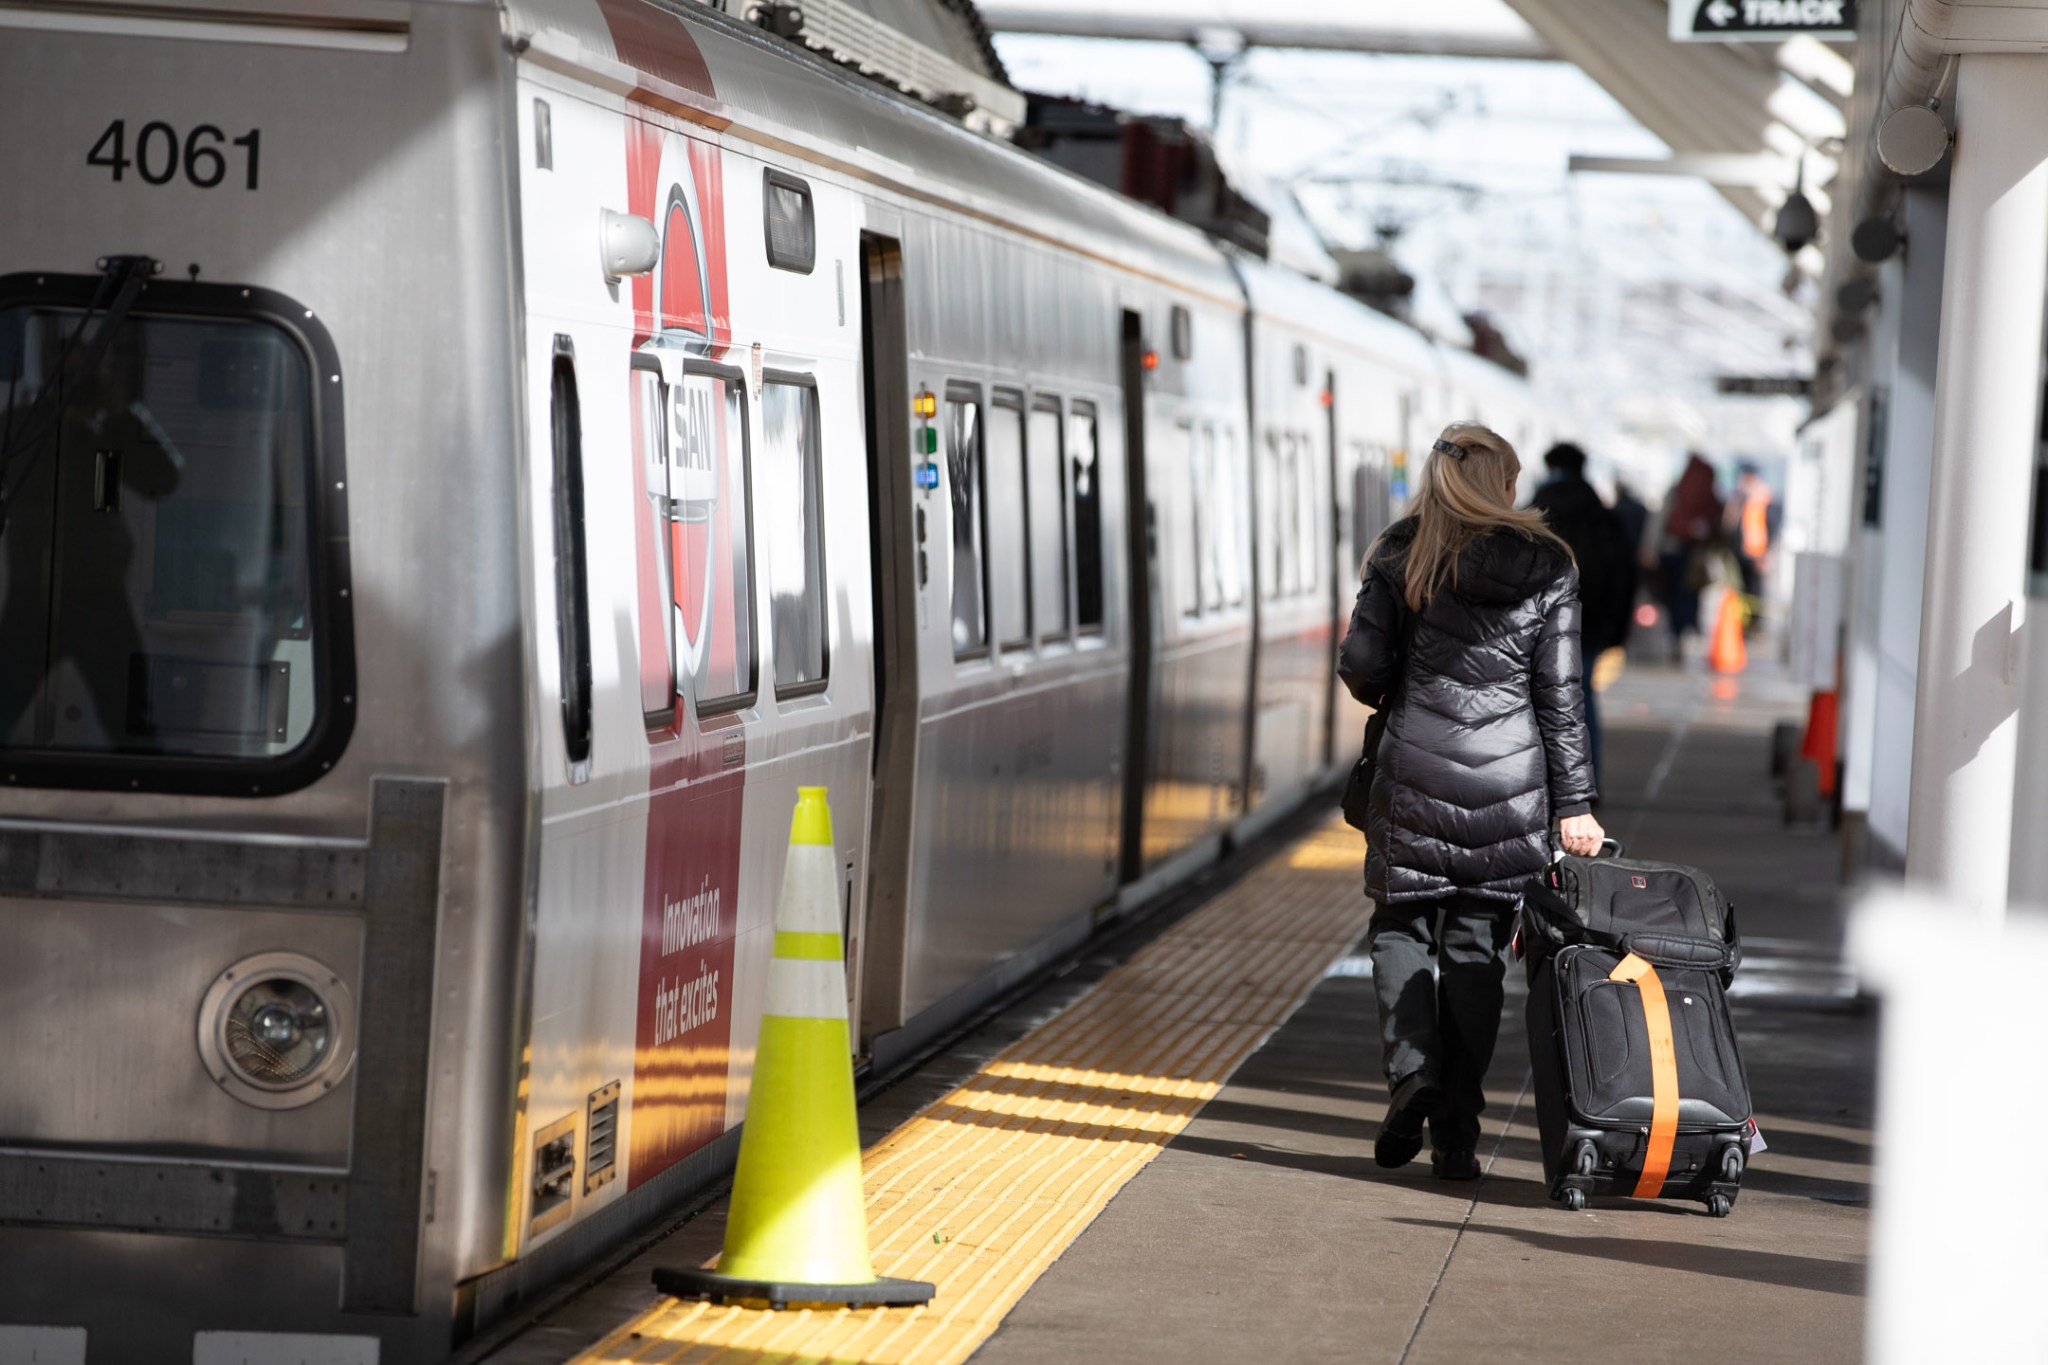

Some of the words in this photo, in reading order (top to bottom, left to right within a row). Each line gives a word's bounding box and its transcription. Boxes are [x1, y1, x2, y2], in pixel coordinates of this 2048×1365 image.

[1741, 0, 1845, 26] TRACK
[86, 118, 261, 190] 4061
[662, 873, 721, 958] Innovation
[655, 975, 680, 1047] that
[680, 958, 719, 1036] excites
